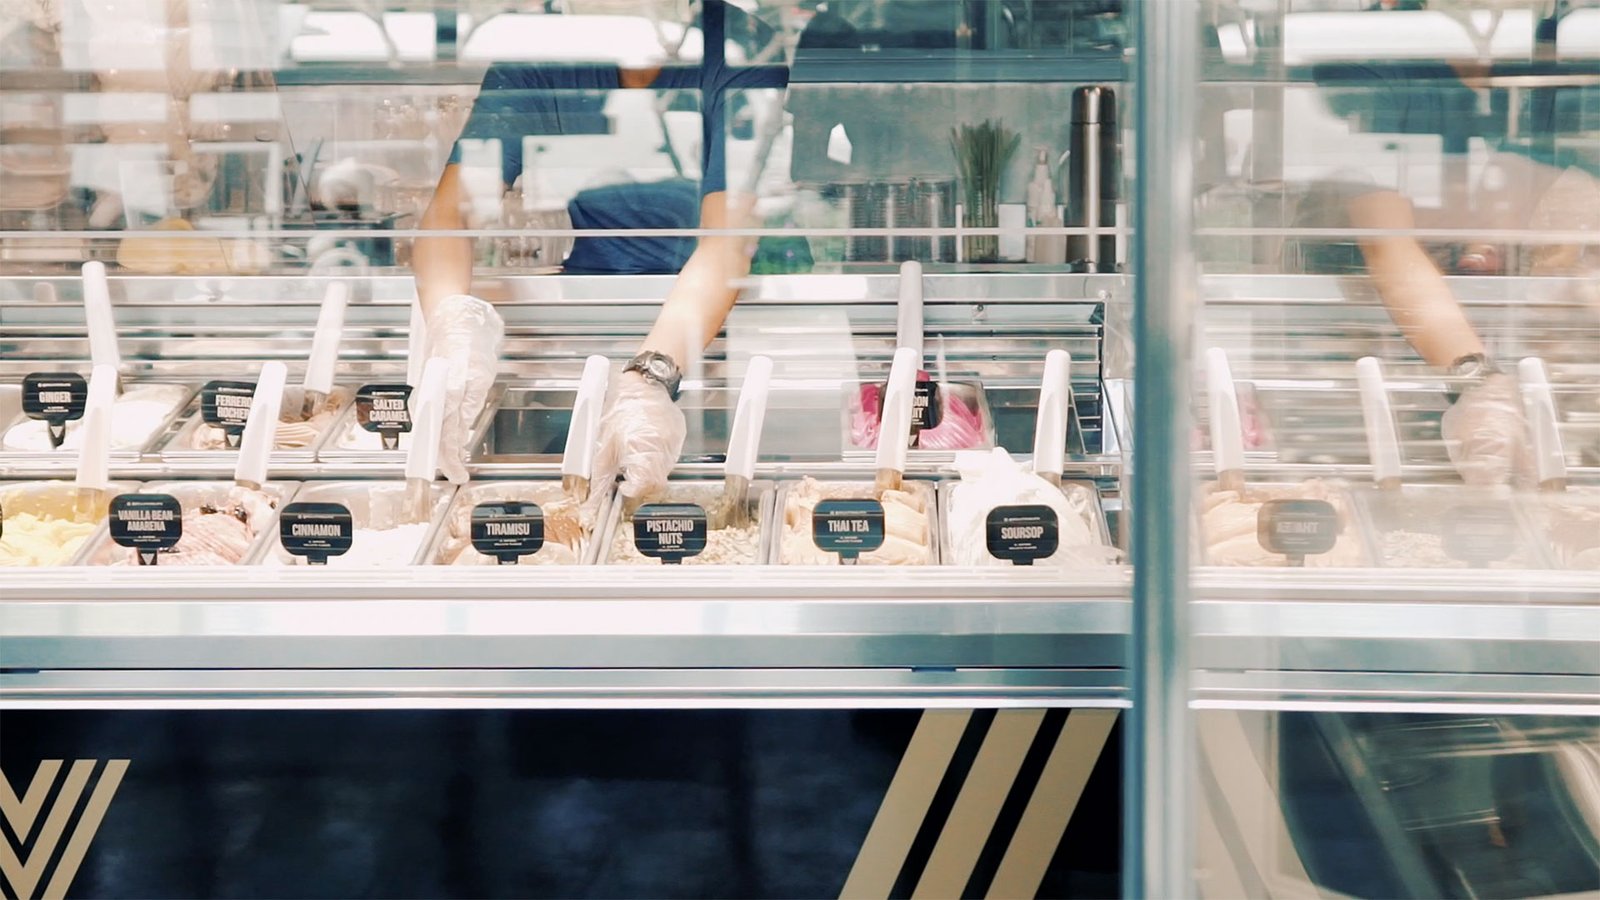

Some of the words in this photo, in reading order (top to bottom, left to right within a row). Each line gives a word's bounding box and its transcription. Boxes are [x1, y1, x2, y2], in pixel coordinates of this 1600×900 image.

[373, 399, 405, 411] SALTED
[369, 410, 410, 422] CARAMEL
[118, 509, 151, 521] VANILLA
[151, 509, 174, 521] BEAN
[127, 520, 167, 532] AMARENA
[292, 523, 342, 537] CINNAMON
[485, 523, 531, 536] TIRAMISU
[646, 519, 694, 533] PISTACHIO
[827, 519, 850, 533] THAI
[851, 519, 870, 533] TEA
[658, 532, 684, 545] NUTS
[1001, 526, 1044, 540] SOURSOP
